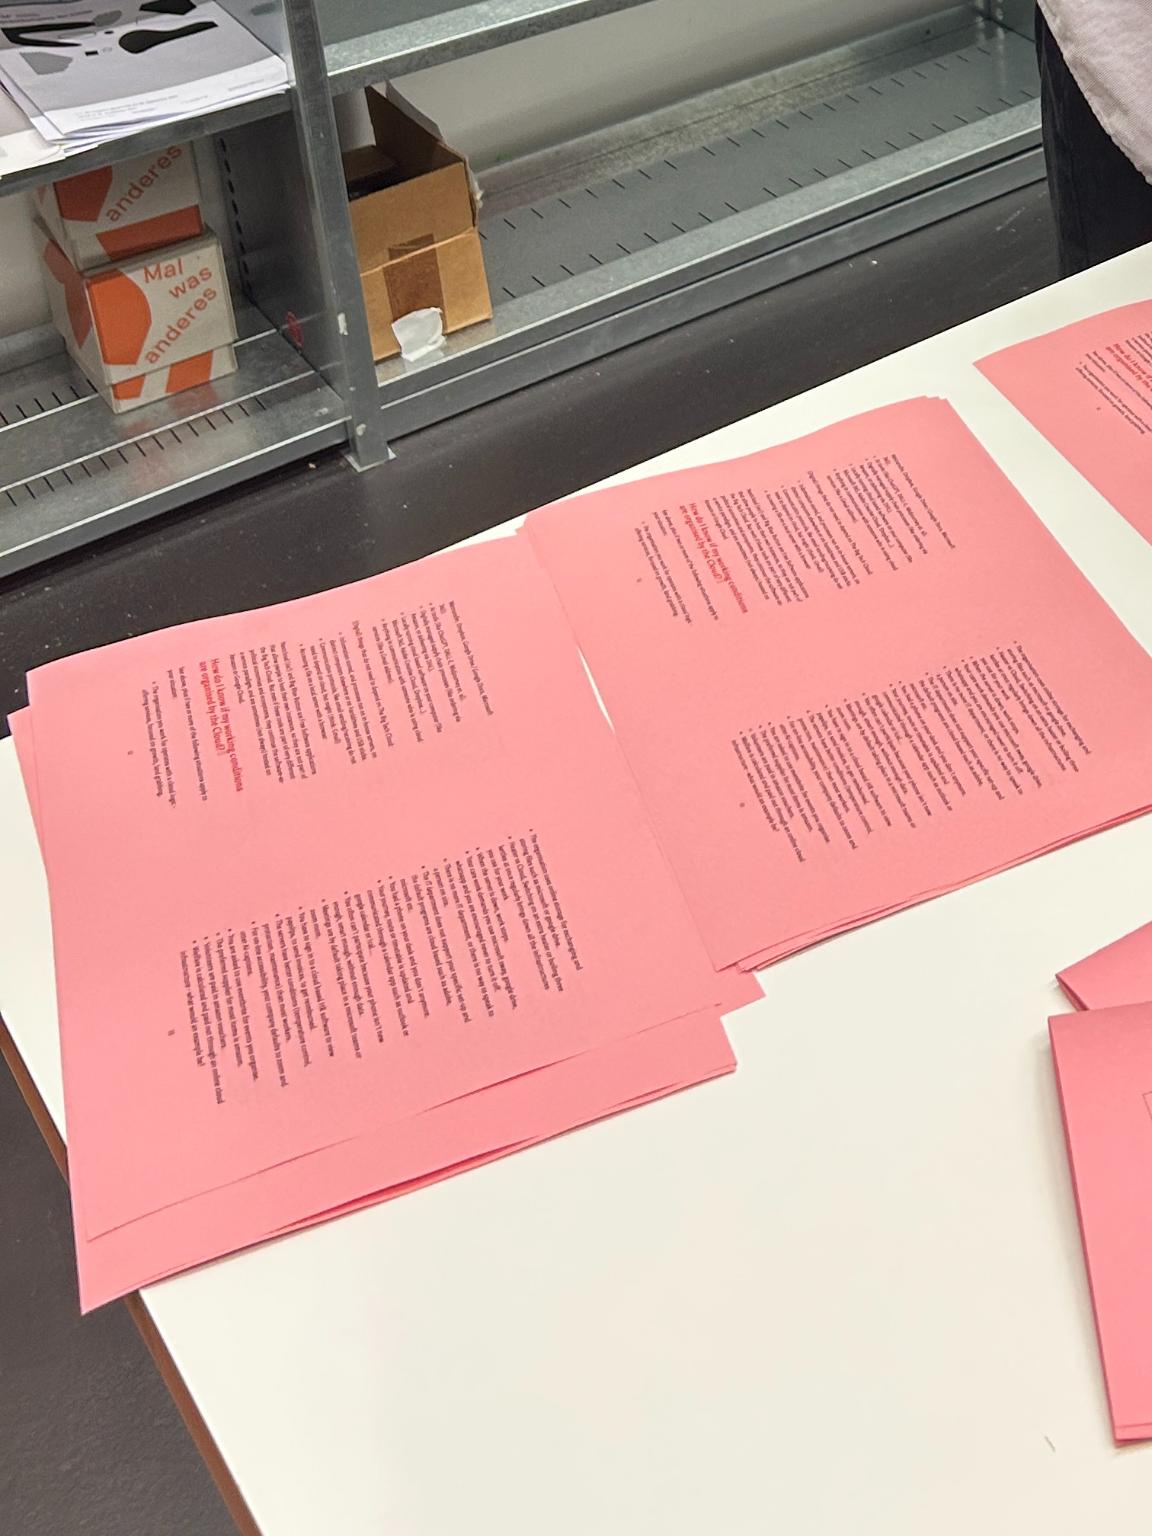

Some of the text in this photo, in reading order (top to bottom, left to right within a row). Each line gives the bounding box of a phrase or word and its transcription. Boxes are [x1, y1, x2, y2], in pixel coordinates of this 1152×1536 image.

[106, 144, 182, 222] anderes
[144, 258, 183, 284] Mal
[169, 267, 212, 298] was
[146, 287, 217, 363] anderes
